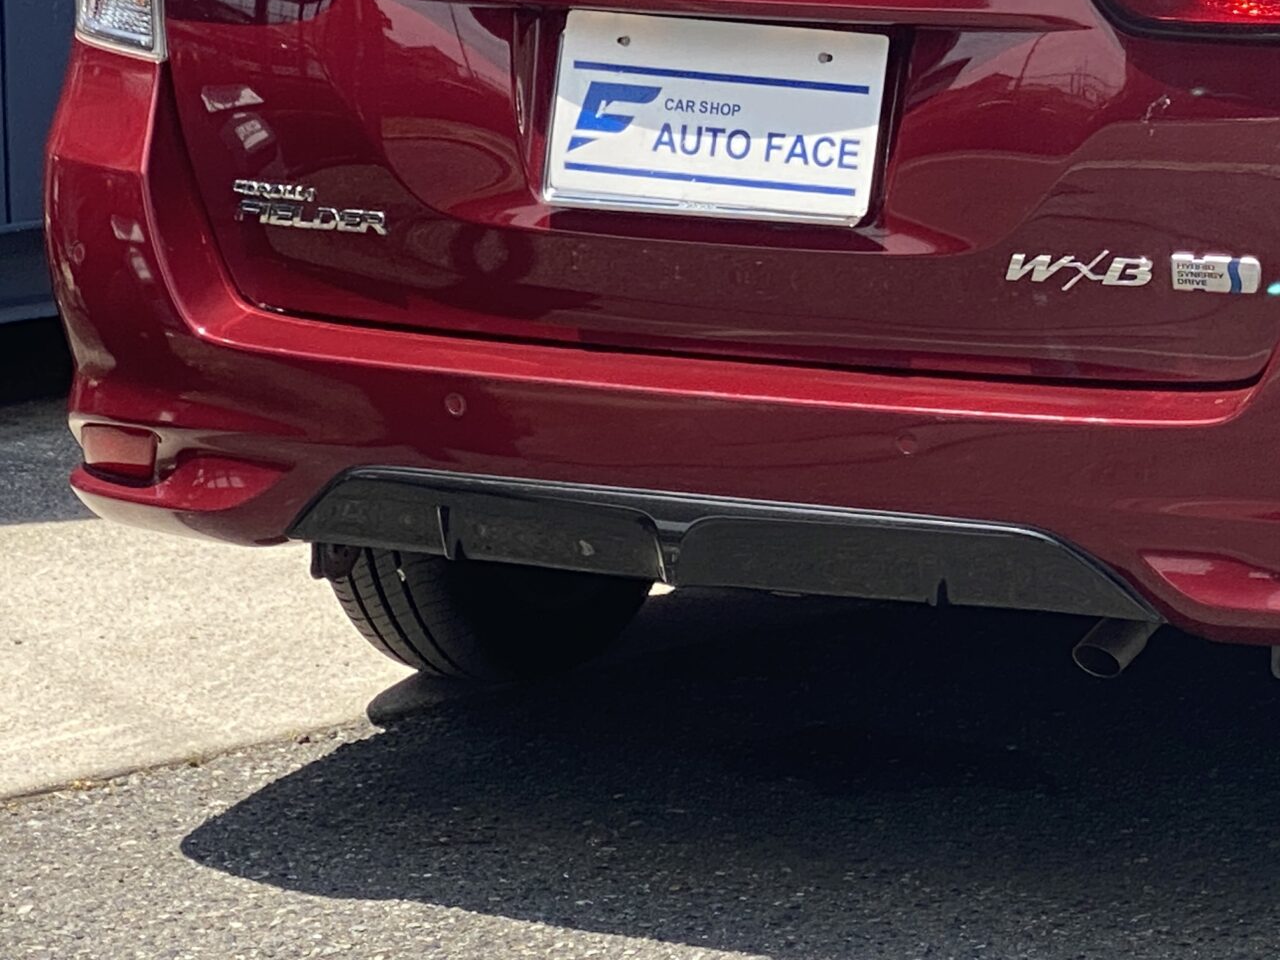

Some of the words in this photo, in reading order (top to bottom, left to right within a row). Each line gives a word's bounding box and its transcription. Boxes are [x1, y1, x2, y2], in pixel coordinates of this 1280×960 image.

[664, 98, 695, 114] CAR
[699, 100, 741, 117] SHOP
[652, 122, 751, 160] AUTO
[764, 132, 861, 170] FACE
[234, 199, 388, 236] FIELDER
[1176, 262, 1216, 271] HYBRID
[1176, 270, 1225, 279] SYNERGY
[1176, 278, 1208, 287] DRIVE
